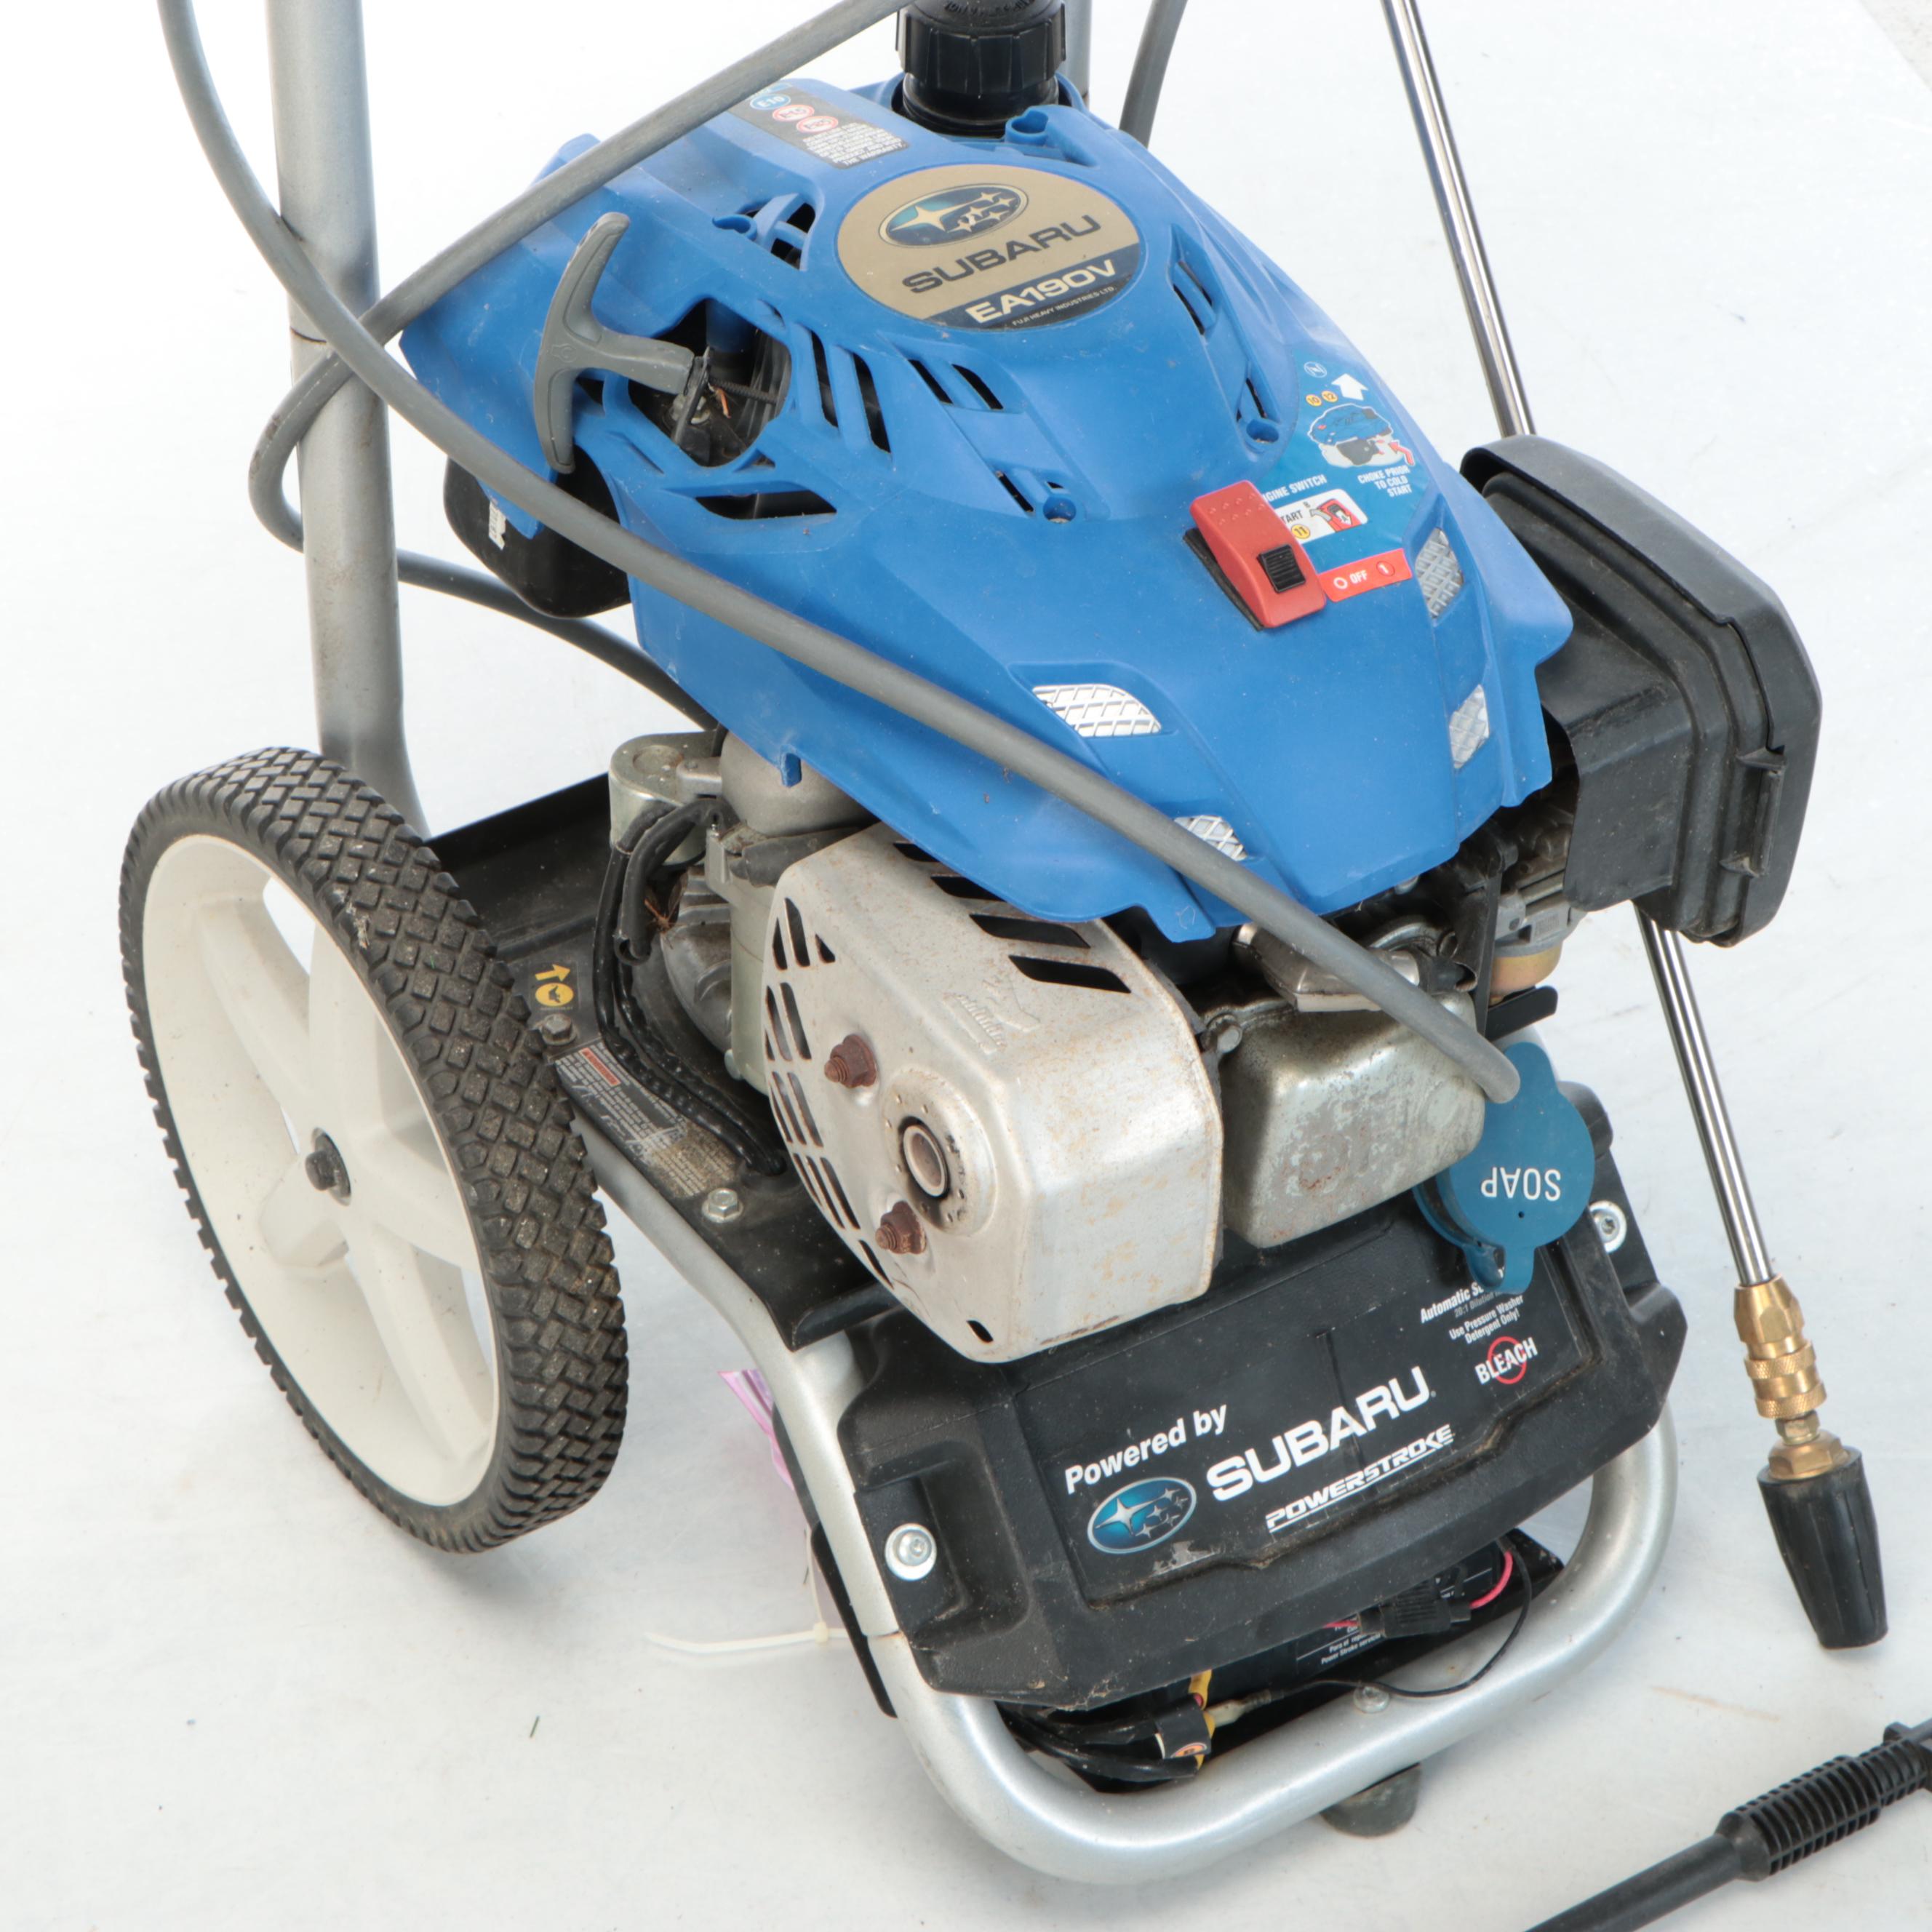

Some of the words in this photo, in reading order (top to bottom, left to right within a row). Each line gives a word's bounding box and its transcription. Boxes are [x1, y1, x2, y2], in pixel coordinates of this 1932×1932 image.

[902, 214, 1101, 294] SUBARU
[965, 258, 1117, 324] EA190V
[1029, 307, 1055, 320] HEAVY
[1055, 291, 1101, 311] INDUSTRIES
[1288, 474, 1328, 495] SWITCH
[1357, 469, 1386, 484] CHOKE
[1384, 464, 1411, 477] PRIOR
[1374, 479, 1387, 490] TO
[1386, 474, 1409, 487] COLD
[1386, 484, 1413, 498] START
[1280, 509, 1304, 524] TART
[1349, 570, 1368, 584] OFF
[1480, 1167, 1562, 1202] SOAP
[1420, 1288, 1471, 1324] Automatic
[1449, 1328, 1466, 1341] Use
[1464, 1309, 1498, 1332] Pressure
[1496, 1295, 1525, 1314] Washer
[1464, 1319, 1501, 1344] Detergent
[1500, 1307, 1521, 1325] Only!
[1474, 1336, 1538, 1385] BLEACH
[1064, 1418, 1187, 1495] Powered
[1193, 1404, 1228, 1436] by
[1206, 1365, 1431, 1501] SUBARU
[1265, 1424, 1456, 1532] POWERSTROKE
